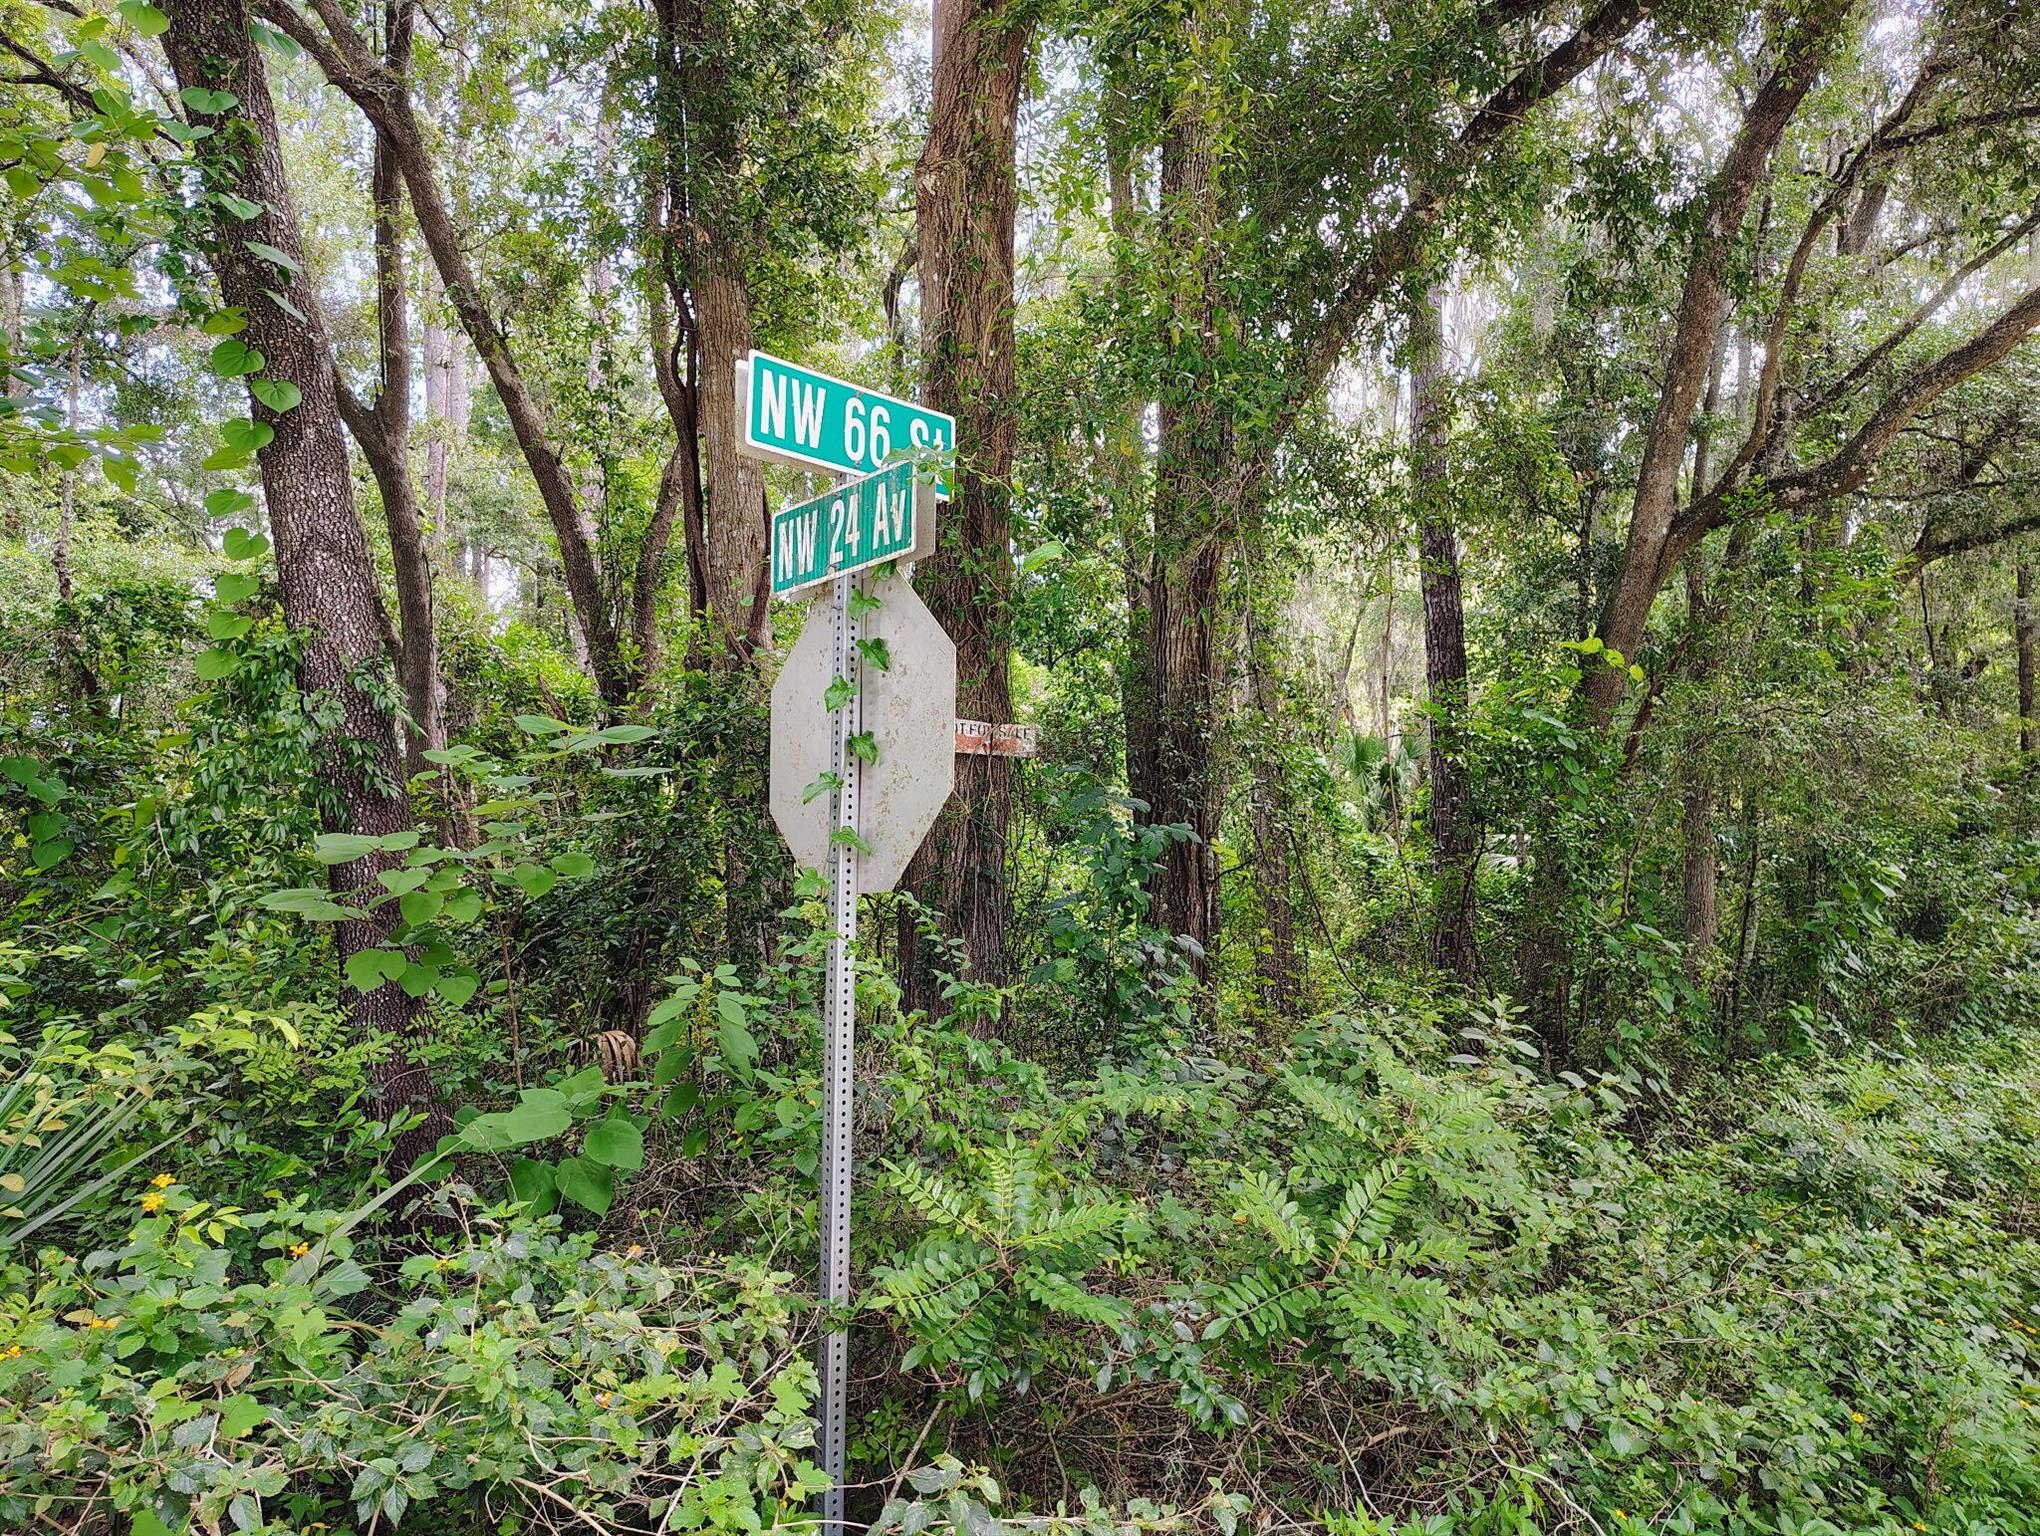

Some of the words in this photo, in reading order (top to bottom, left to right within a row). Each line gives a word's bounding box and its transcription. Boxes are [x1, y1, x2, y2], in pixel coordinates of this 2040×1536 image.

[760, 368, 827, 449] NW
[843, 396, 891, 468] 66
[778, 509, 818, 582] NW
[830, 493, 861, 565] 24
[872, 482, 906, 550] Av
